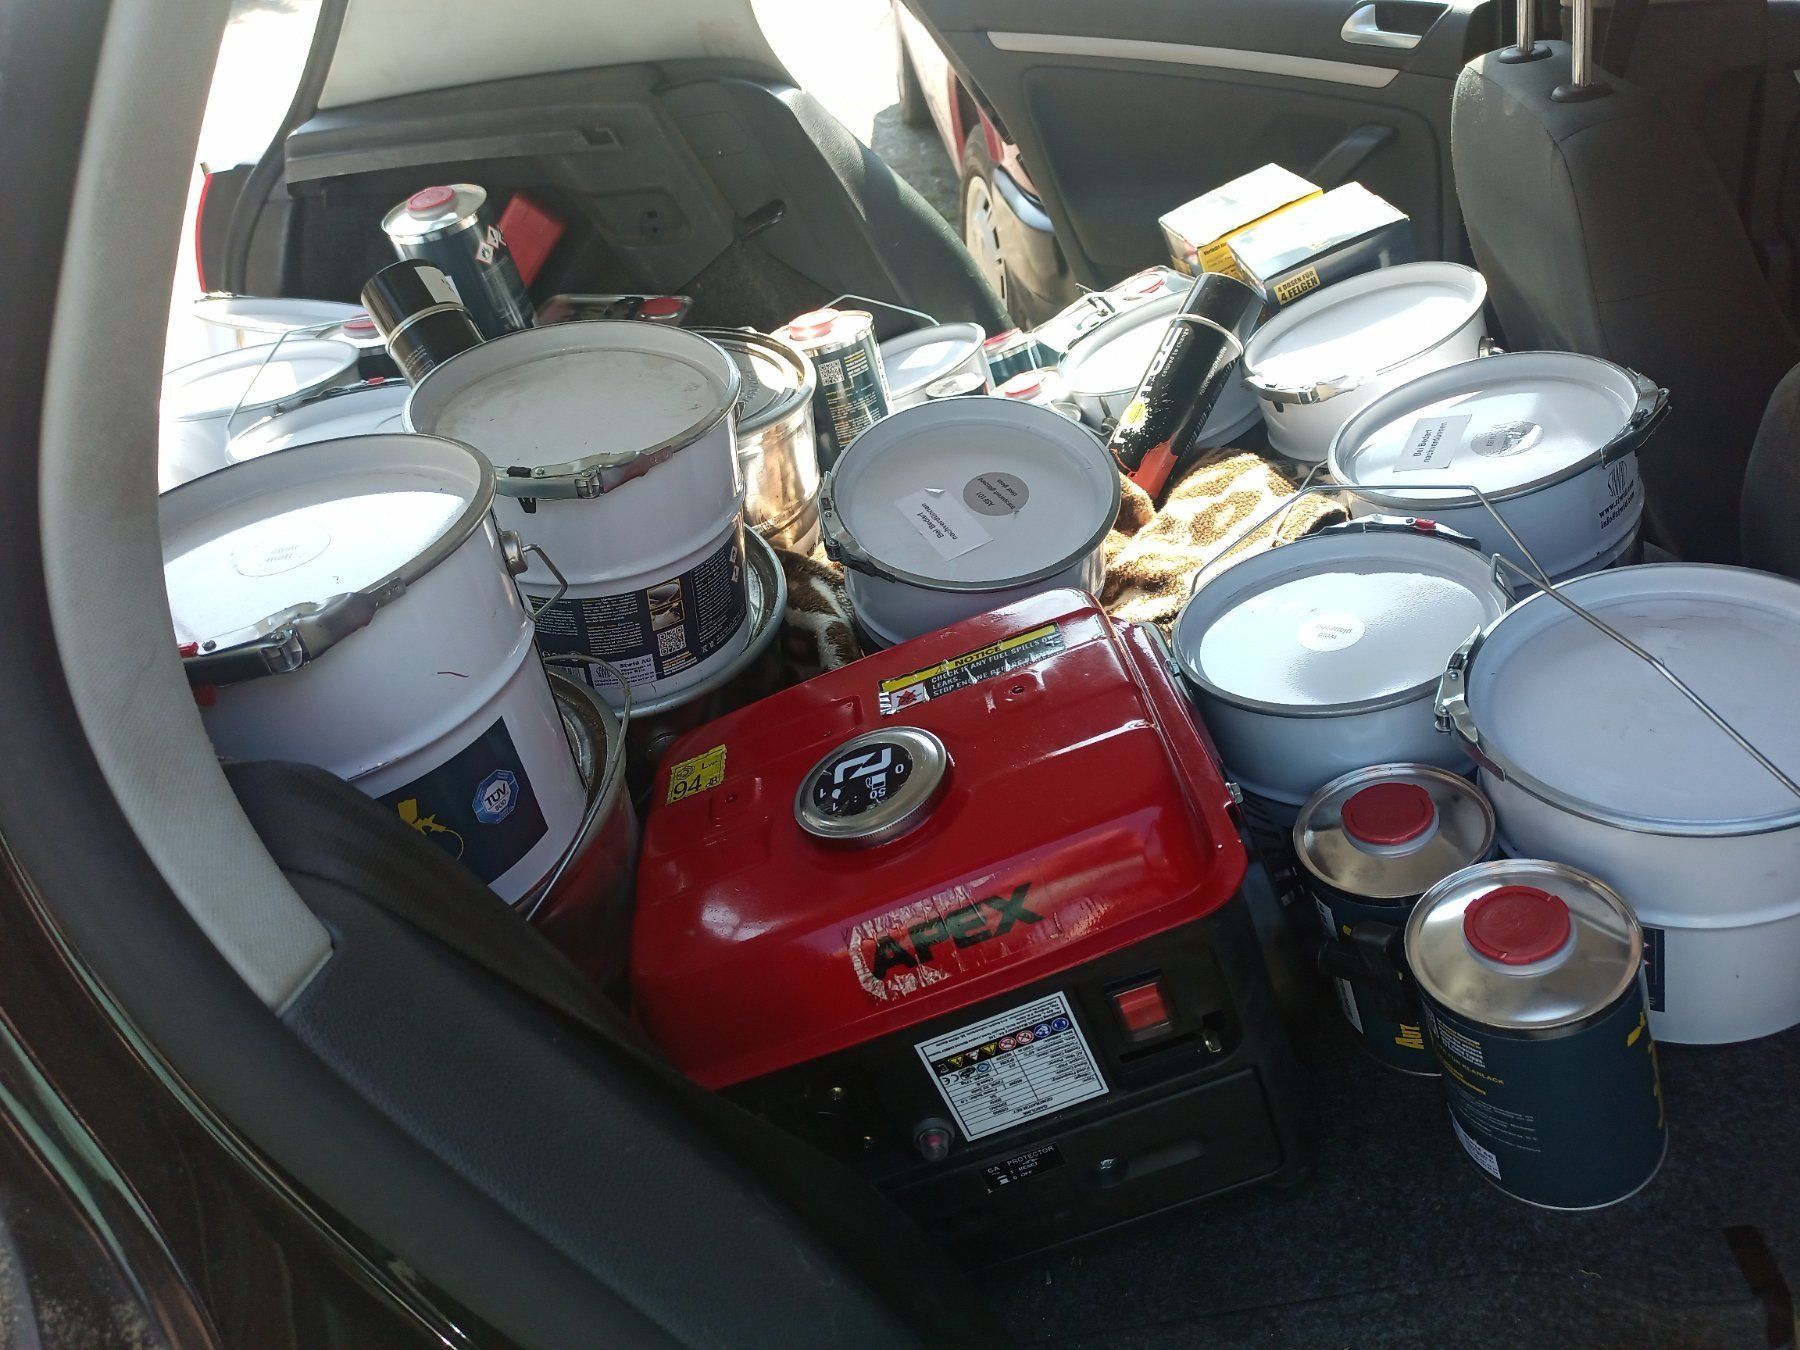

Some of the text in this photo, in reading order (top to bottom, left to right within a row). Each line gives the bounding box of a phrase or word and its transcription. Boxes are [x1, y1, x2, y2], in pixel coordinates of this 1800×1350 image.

[1288, 276, 1319, 299] FELGEN
[916, 512, 945, 539] Bei Bedarf
[954, 645, 1002, 667] NOTICE
[970, 659, 987, 670] ANY
[988, 651, 1009, 663] FUEL
[1010, 641, 1040, 655] SPILLS
[932, 677, 962, 691] LEAKS.
[933, 684, 955, 697] STOP
[956, 672, 989, 690] ENGNE
[673, 774, 702, 800] 94
[873, 881, 1043, 979] APEX
[1006, 1145, 1054, 1166] PROTECTOR
